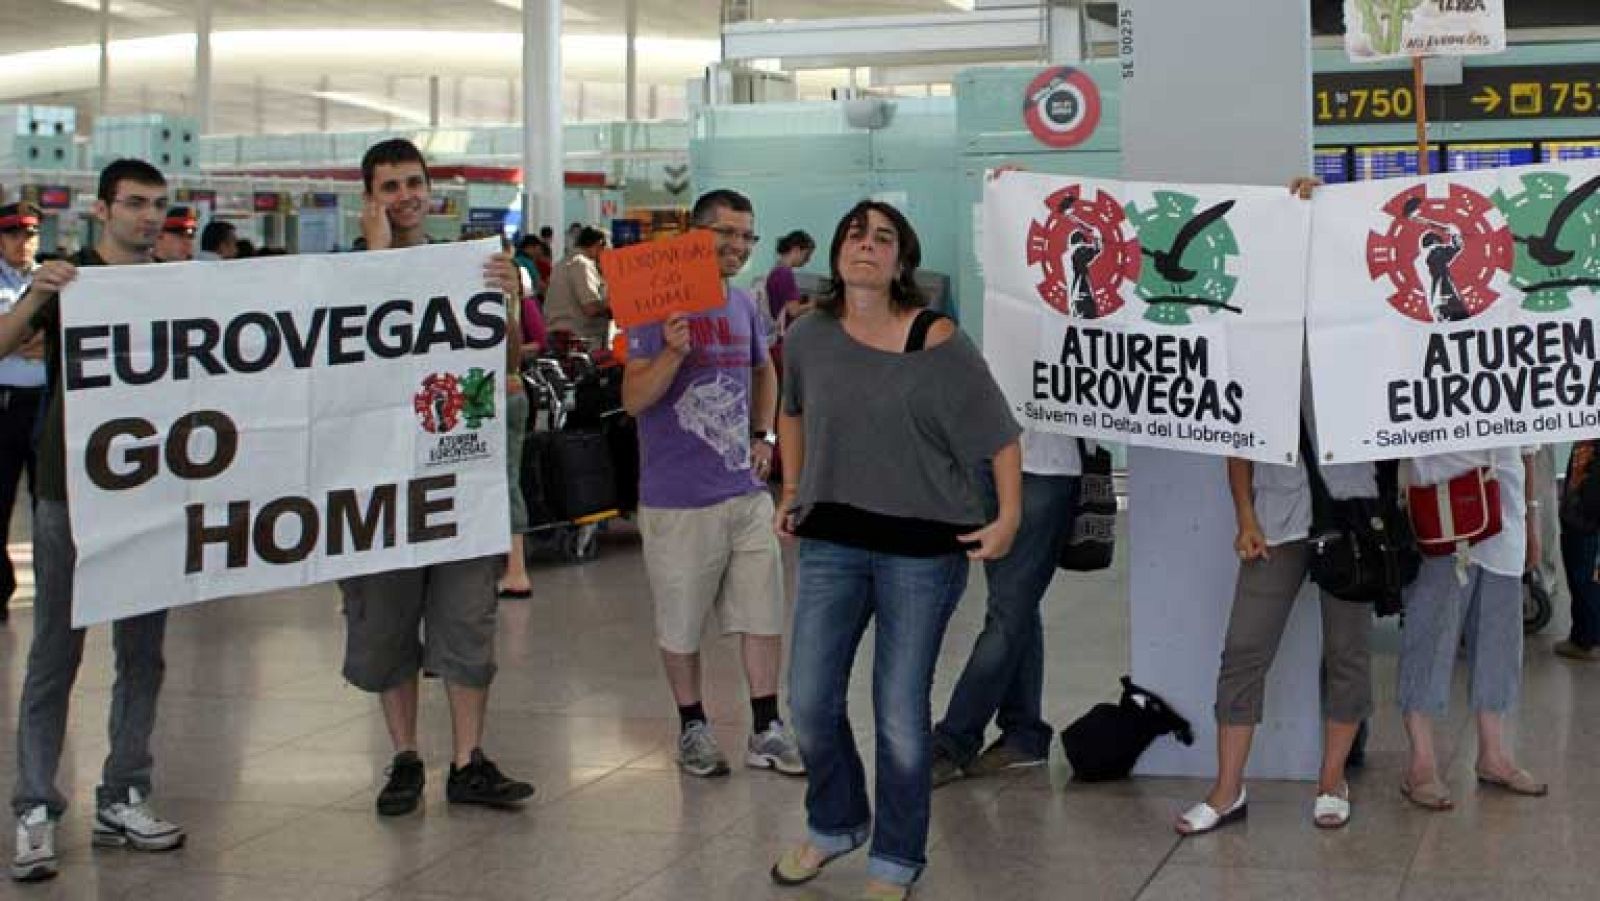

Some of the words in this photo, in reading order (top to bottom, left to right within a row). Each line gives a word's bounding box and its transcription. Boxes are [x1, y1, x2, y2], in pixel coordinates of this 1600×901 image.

[1120, 9, 1134, 55] 00275
[1121, 60, 1135, 79] SE
[1316, 91, 1333, 119] 1
[1349, 87, 1412, 118] 750
[1551, 82, 1600, 111] 75
[64, 291, 506, 391] EUROVEGAS
[1060, 325, 1209, 378] ATUREM
[1423, 317, 1596, 378] ATUREM
[1033, 360, 1244, 424] EUROVEGAS
[85, 410, 239, 490] GO
[1025, 401, 1078, 424] Salvem
[1083, 413, 1097, 428] el
[1101, 413, 1142, 435] Delta
[1149, 420, 1172, 437] del
[1178, 426, 1255, 449] Llobregat
[1376, 427, 1447, 447] Salvem
[1453, 421, 1470, 439] el
[1476, 417, 1527, 437] Delta
[1533, 412, 1561, 431] del
[184, 473, 459, 575] HOME
